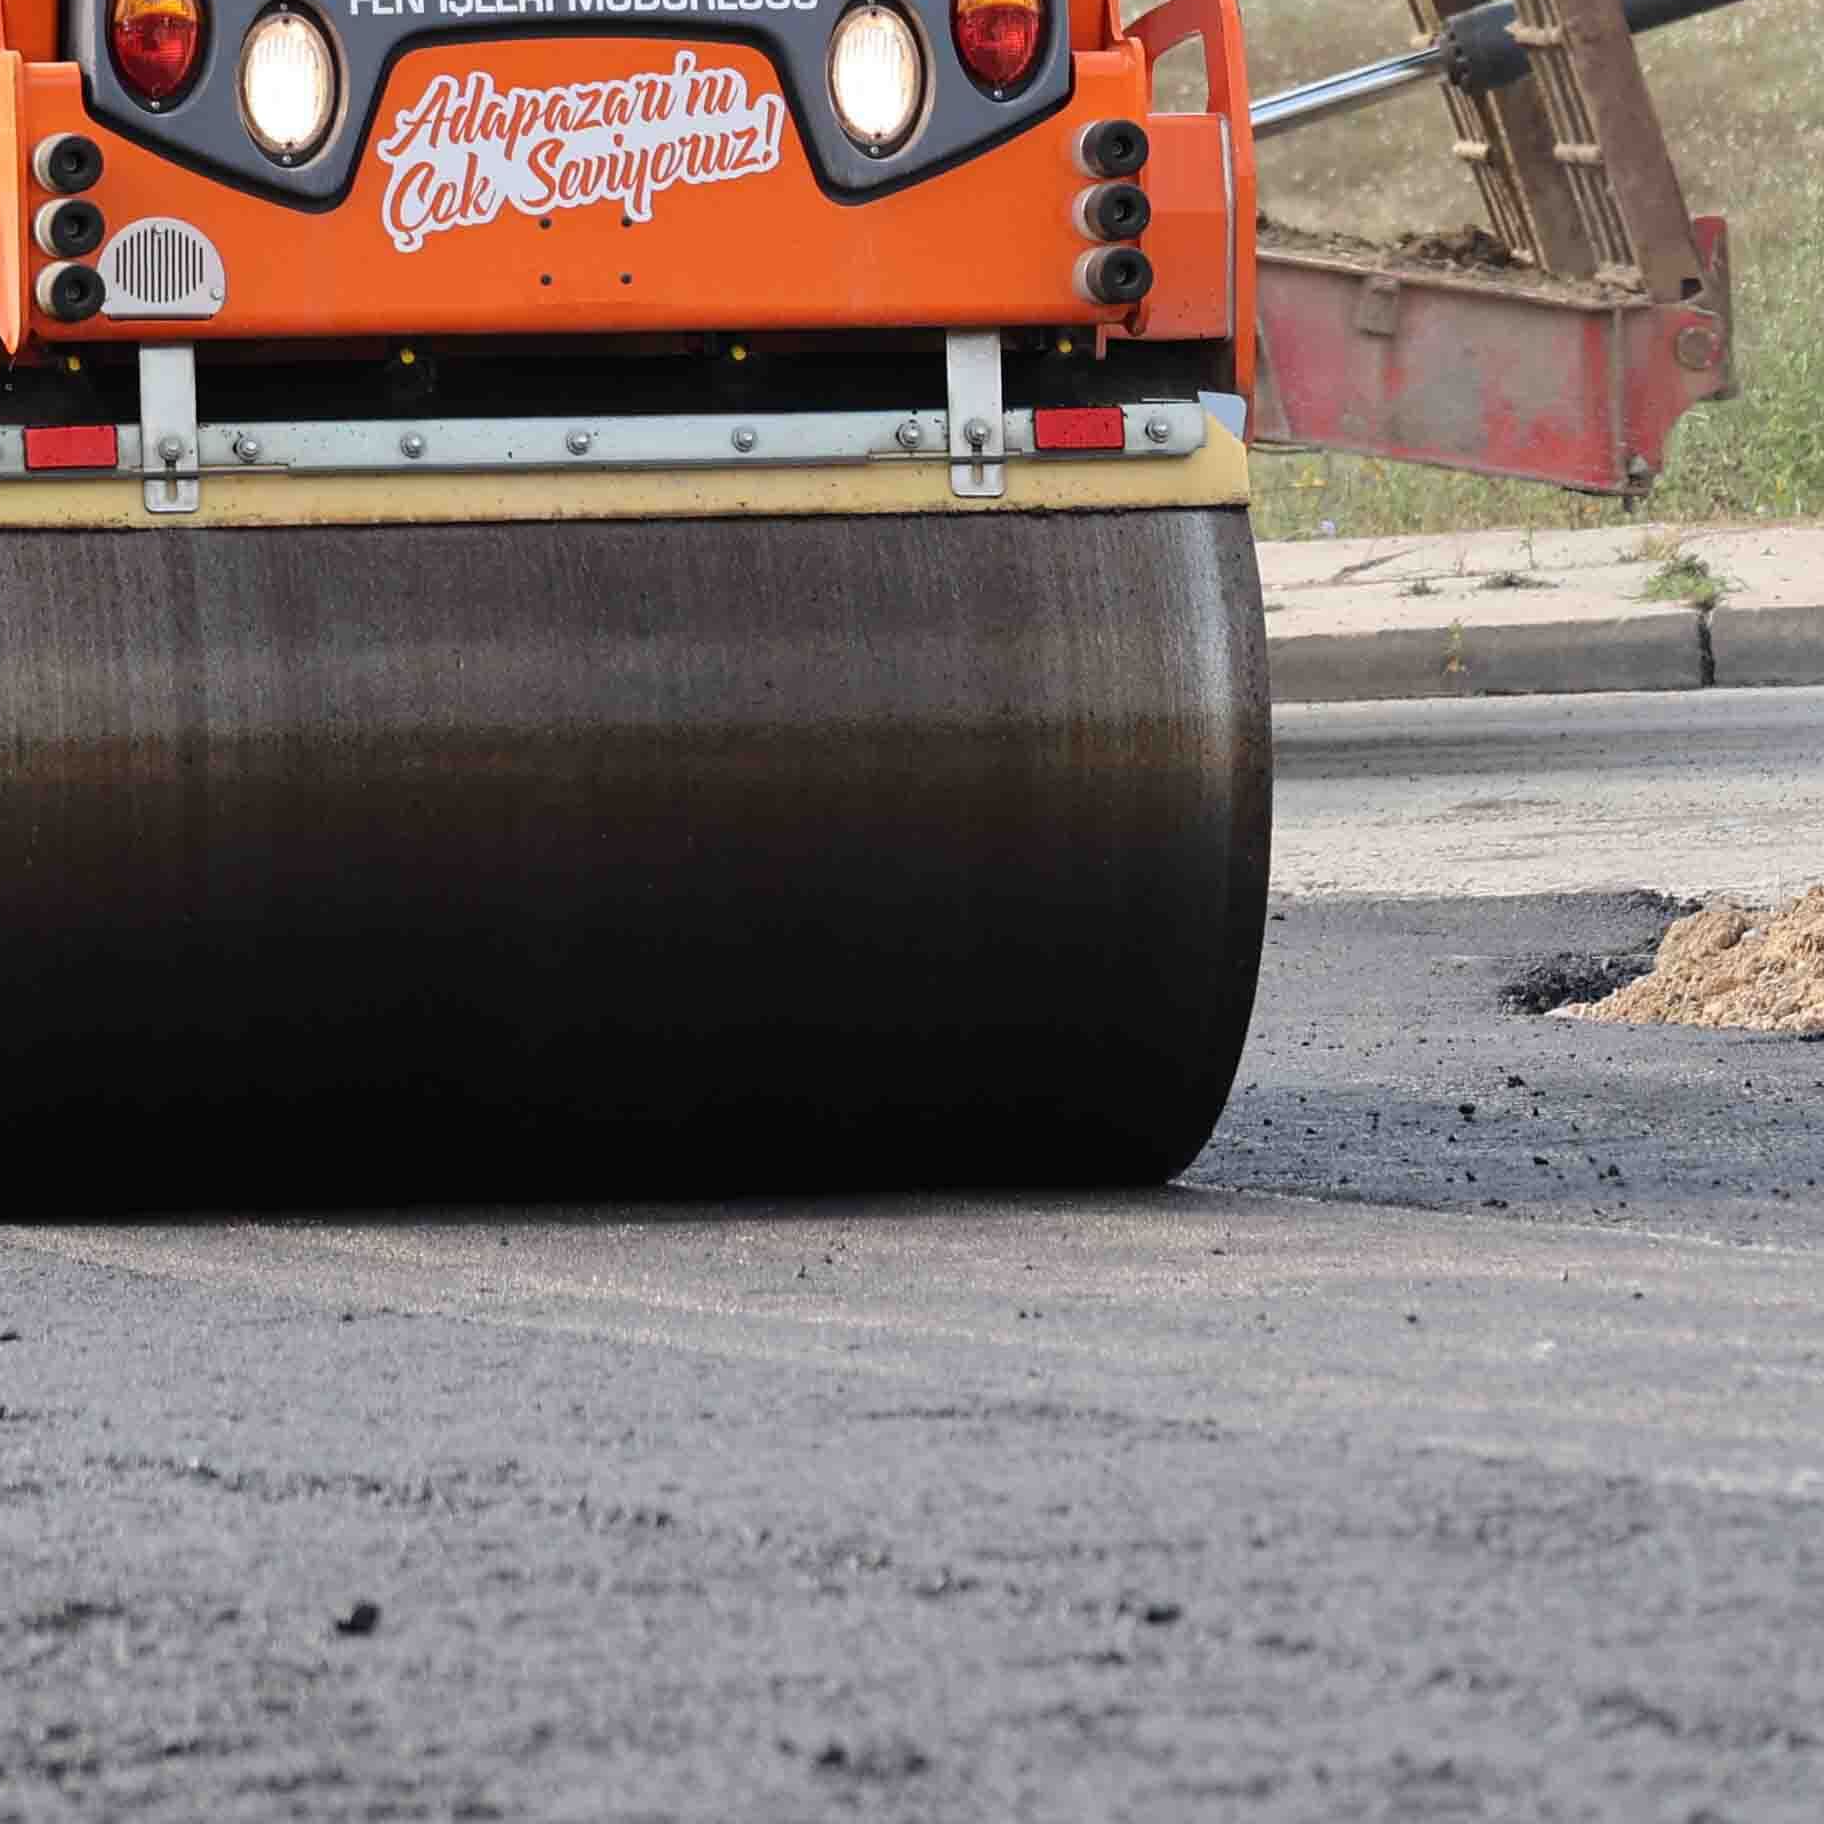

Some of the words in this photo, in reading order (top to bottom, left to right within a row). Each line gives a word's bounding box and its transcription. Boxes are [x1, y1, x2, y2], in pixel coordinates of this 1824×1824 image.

[386, 57, 739, 160] Adapazarı'nı
[391, 152, 496, 245] Çok
[520, 100, 778, 214] Seviyoruz!
